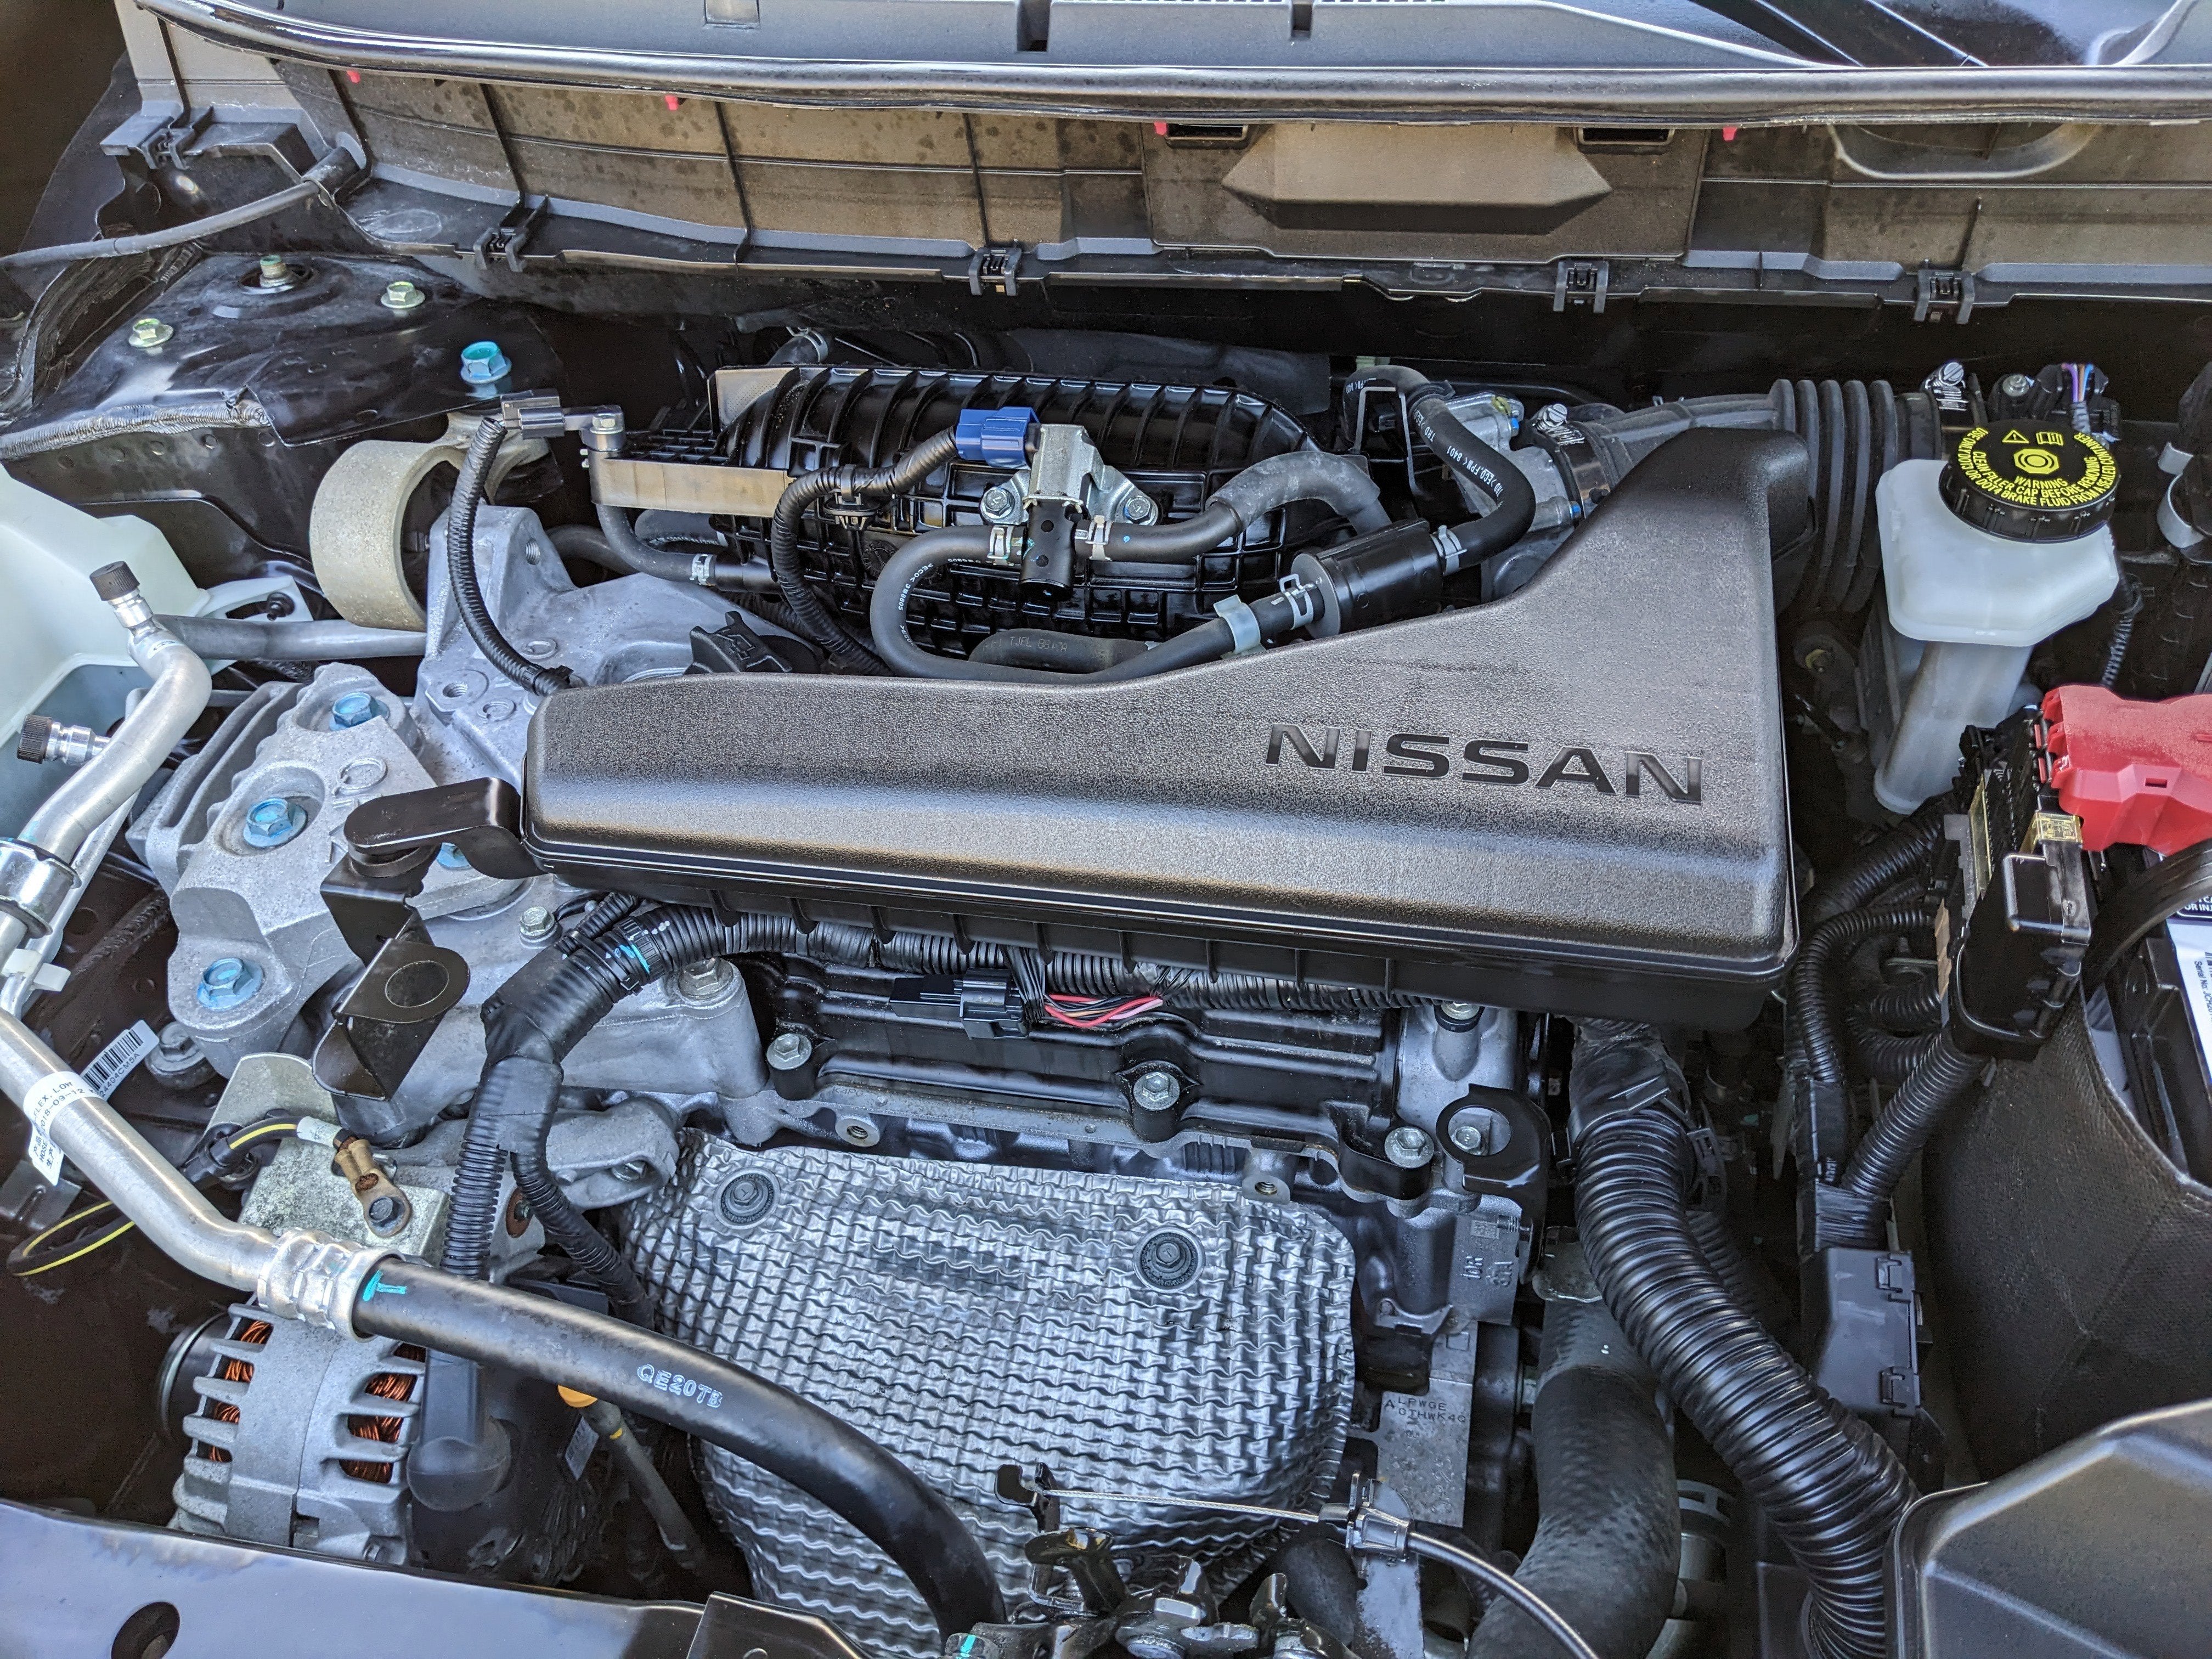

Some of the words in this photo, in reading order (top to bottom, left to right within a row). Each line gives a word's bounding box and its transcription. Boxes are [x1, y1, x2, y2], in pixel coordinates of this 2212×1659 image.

[1424, 426, 1436, 442] TRD
[1967, 427, 1989, 441] USE
[1447, 445, 1463, 462] 8401
[1958, 437, 1976, 454] ONLY
[2074, 432, 2115, 465] CONTAINER
[1965, 470, 1982, 481] OR
[1972, 451, 1991, 472] CLEAN
[1982, 471, 2015, 491] FILLER
[2016, 486, 2039, 497] CAP
[2040, 483, 2085, 498] BEFORE
[2076, 456, 2101, 489] REMOVING
[2014, 476, 2068, 489] WARNING
[2096, 466, 2116, 489] SEALED
[1975, 478, 2003, 495] DOT4
[2092, 486, 2106, 494] A
[2000, 490, 2038, 506] BRAKE
[2039, 497, 2072, 507] FLUID
[2069, 488, 2100, 505] FROM
[1264, 723, 1703, 805] NISSAN
[2194, 961, 2207, 978] Serial
[38, 1139, 48, 1163] HOSE
[52, 1081, 73, 1094] LOW
[636, 1363, 723, 1408] QE20TB
[1384, 1399, 1395, 1410] A
